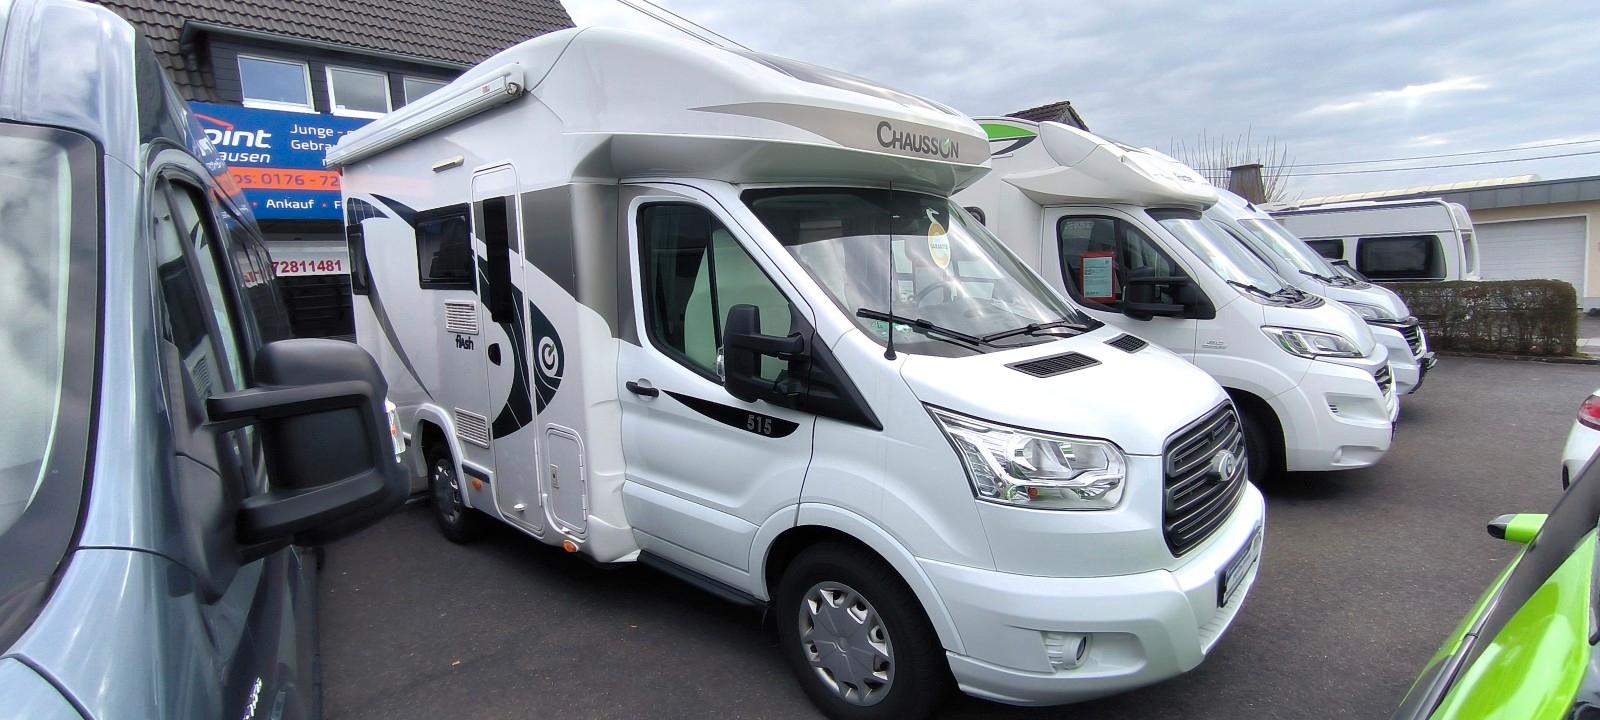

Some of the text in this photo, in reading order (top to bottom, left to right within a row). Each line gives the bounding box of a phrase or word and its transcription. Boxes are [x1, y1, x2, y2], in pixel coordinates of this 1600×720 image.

[203, 128, 272, 149] oint
[290, 123, 334, 139] Junge
[291, 139, 337, 151] Gebra
[876, 121, 959, 159] CHAUSSON
[218, 151, 271, 163] ausen
[261, 172, 305, 186] 0176
[319, 175, 340, 187] 72
[266, 199, 315, 209] Ankauf
[746, 414, 772, 435] 515
